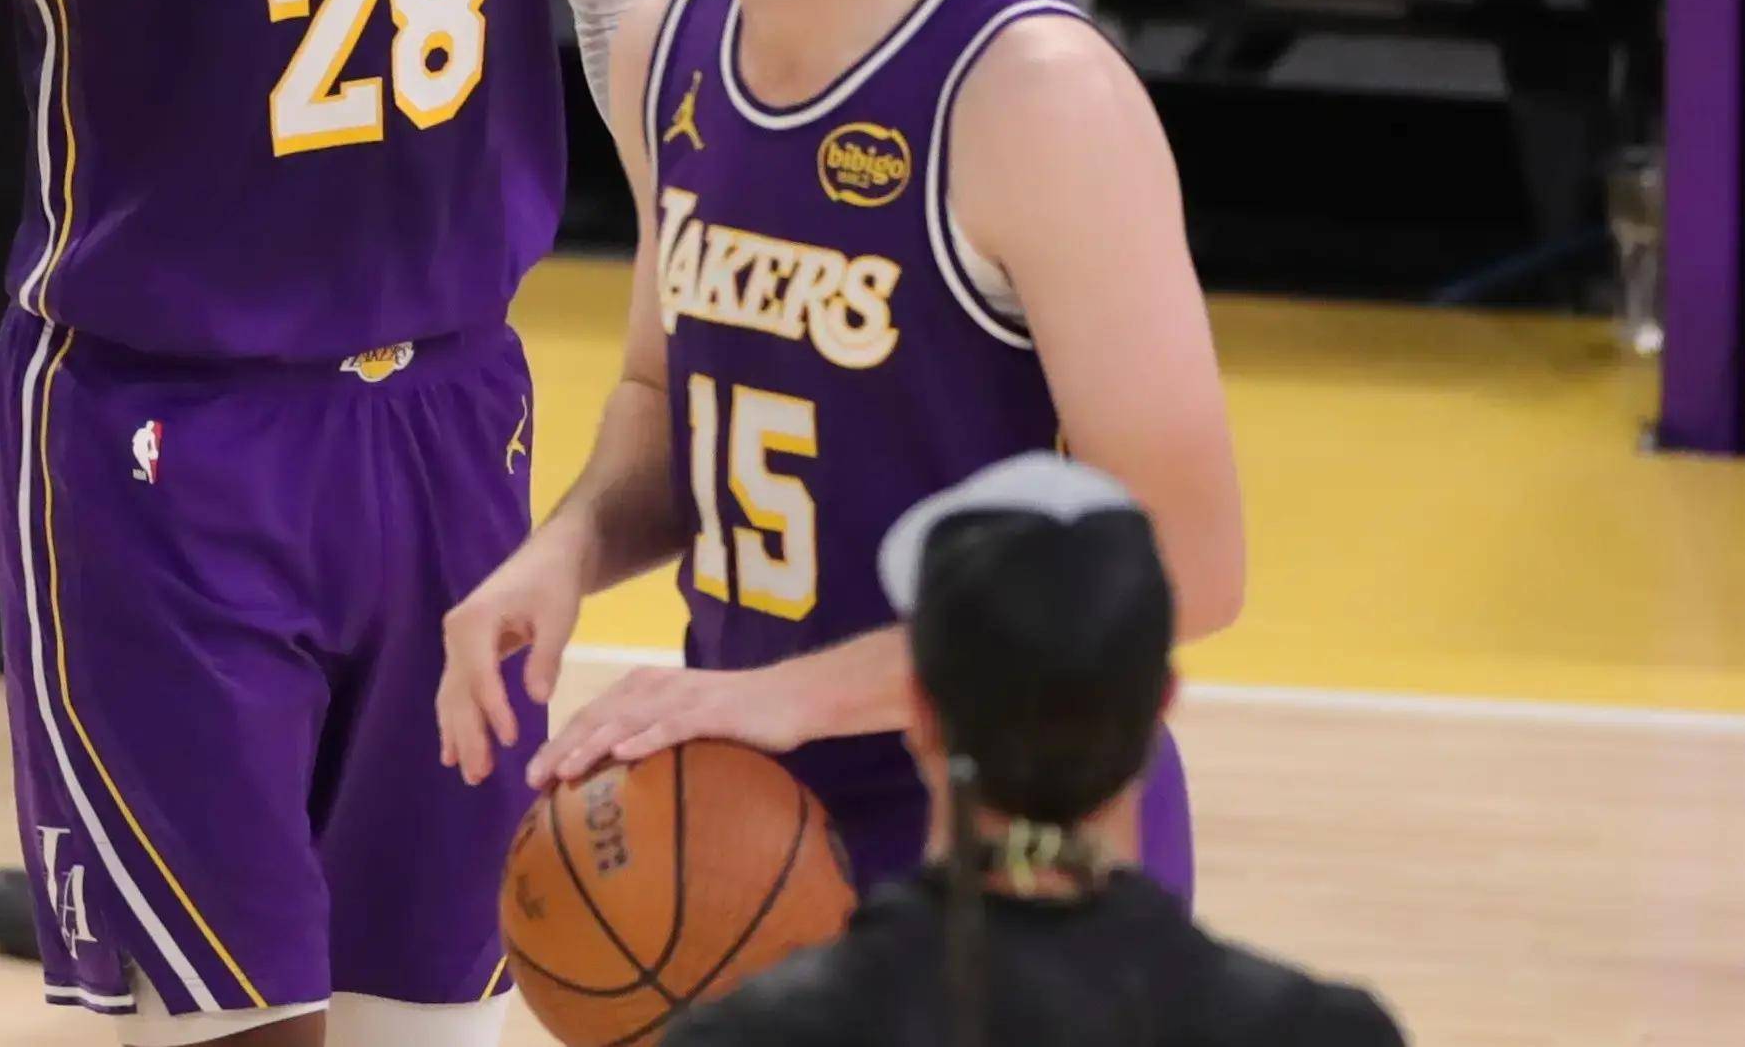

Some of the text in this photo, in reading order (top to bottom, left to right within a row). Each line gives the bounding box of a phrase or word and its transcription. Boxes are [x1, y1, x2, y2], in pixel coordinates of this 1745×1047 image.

[827, 141, 905, 186] bibigo
[657, 186, 903, 370] LAKERS
[687, 371, 819, 623] 15
